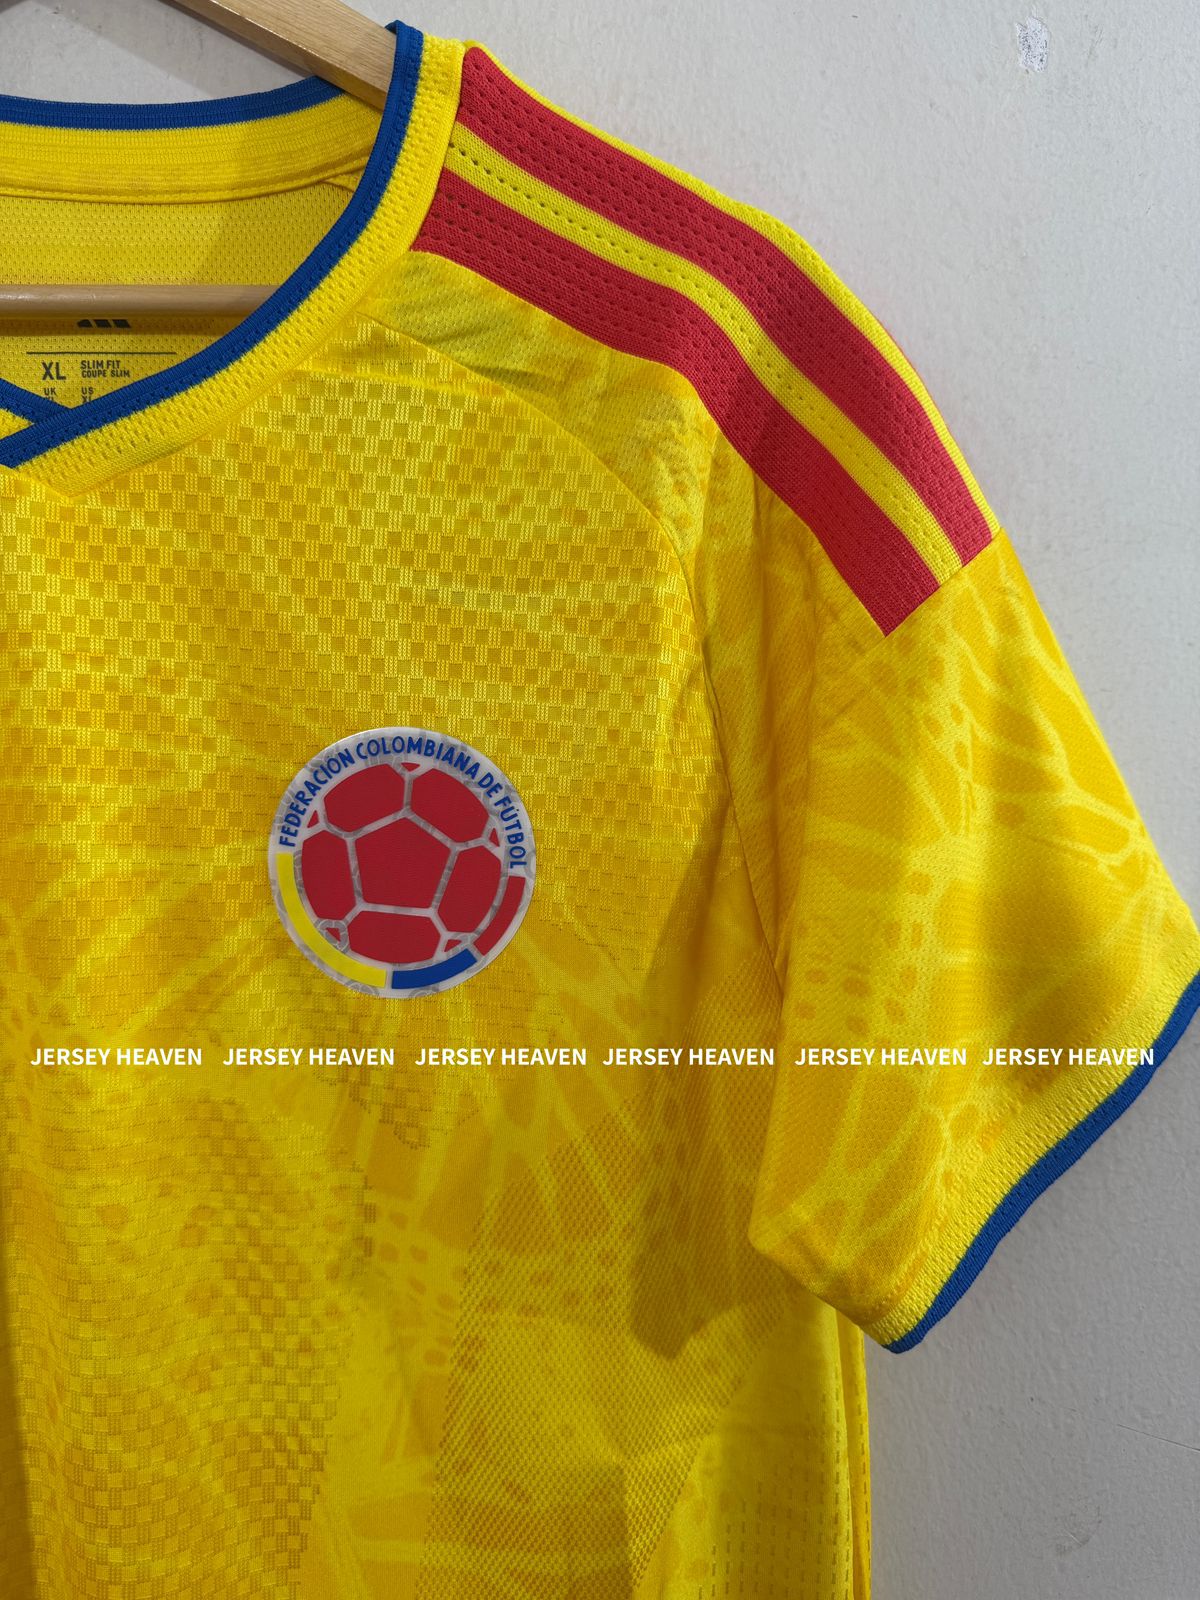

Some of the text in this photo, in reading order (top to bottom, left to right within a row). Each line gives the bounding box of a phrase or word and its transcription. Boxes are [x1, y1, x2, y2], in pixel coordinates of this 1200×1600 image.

[81, 360, 121, 370] SLIM FIT
[42, 362, 66, 380] XL
[81, 370, 130, 378] COUPE SLIM
[44, 387, 56, 396] UK
[81, 386, 94, 395] US
[356, 736, 480, 781] COLOMBIANA
[477, 771, 501, 798] DE
[494, 795, 527, 869] FÚTBOL
